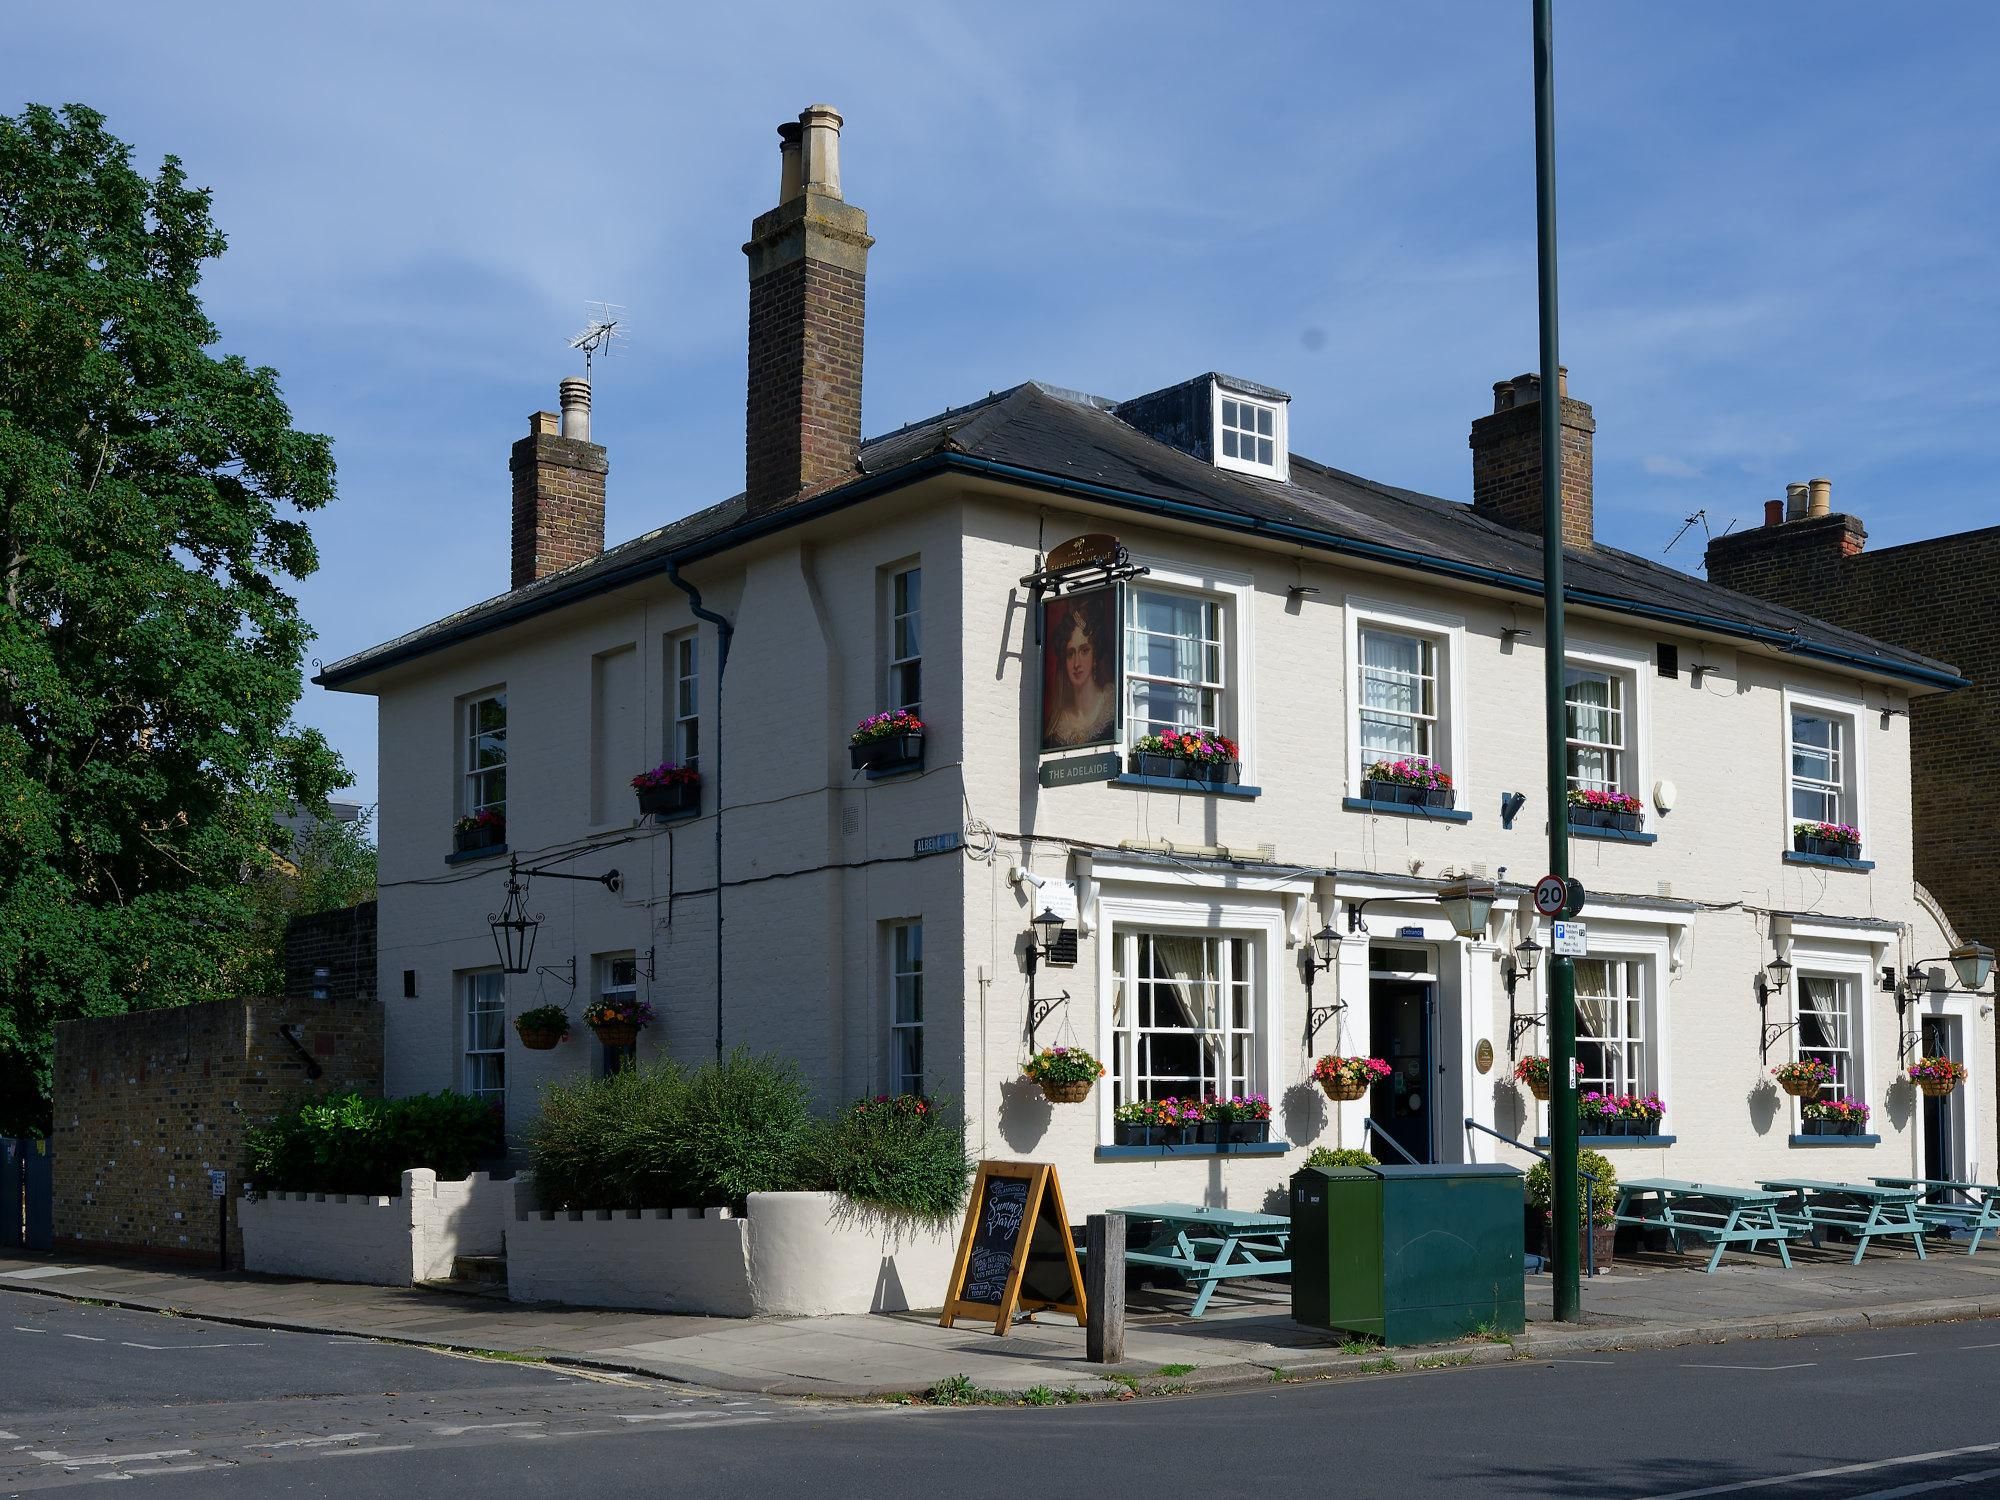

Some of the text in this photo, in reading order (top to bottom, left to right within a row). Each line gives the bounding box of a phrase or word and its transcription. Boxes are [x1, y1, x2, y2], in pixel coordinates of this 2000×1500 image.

[1049, 763, 1108, 779] THE ADELAIDE
[1539, 887, 1561, 904] 20
[988, 1197, 1022, 1220] Summer
